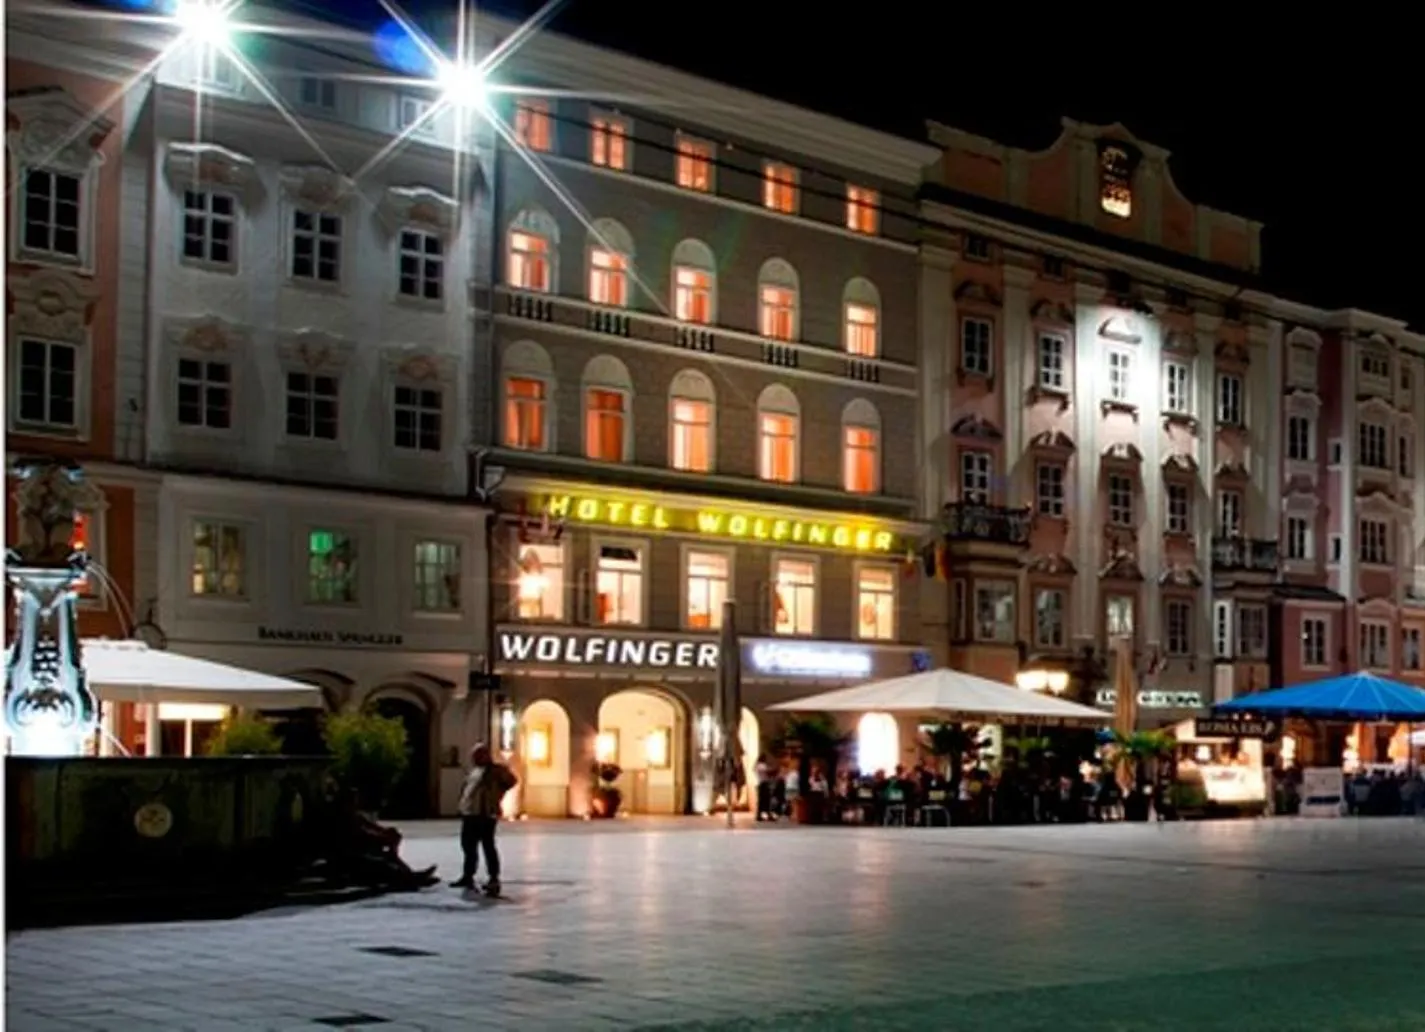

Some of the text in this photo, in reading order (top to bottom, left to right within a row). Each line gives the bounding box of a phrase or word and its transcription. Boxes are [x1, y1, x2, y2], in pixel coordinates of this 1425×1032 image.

[549, 494, 893, 552] HOTEL WOLFINGER
[500, 633, 720, 668] WOLFINGER
